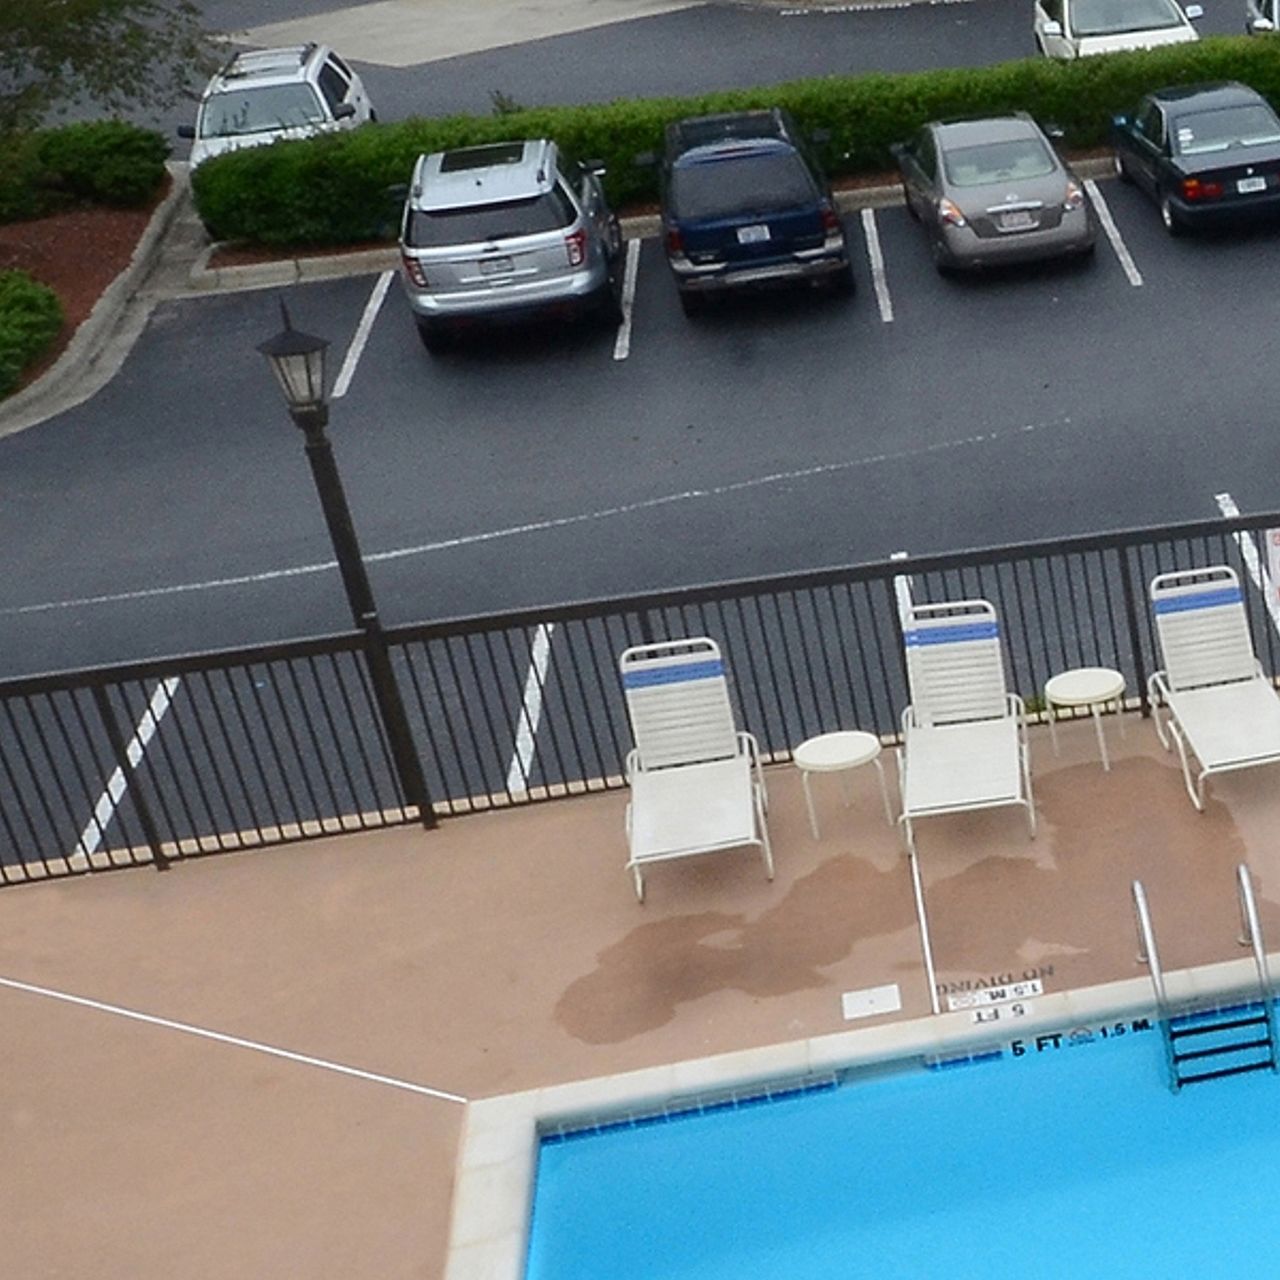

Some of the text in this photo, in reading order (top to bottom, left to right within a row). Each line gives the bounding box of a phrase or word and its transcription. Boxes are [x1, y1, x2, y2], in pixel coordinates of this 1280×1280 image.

[936, 973, 1013, 995] DIVING
[974, 1003, 1025, 1024] 5 FT
[1011, 1040, 1026, 1057] 5
[1036, 1034, 1062, 1052] FT
[1100, 1022, 1126, 1039] 1.5
